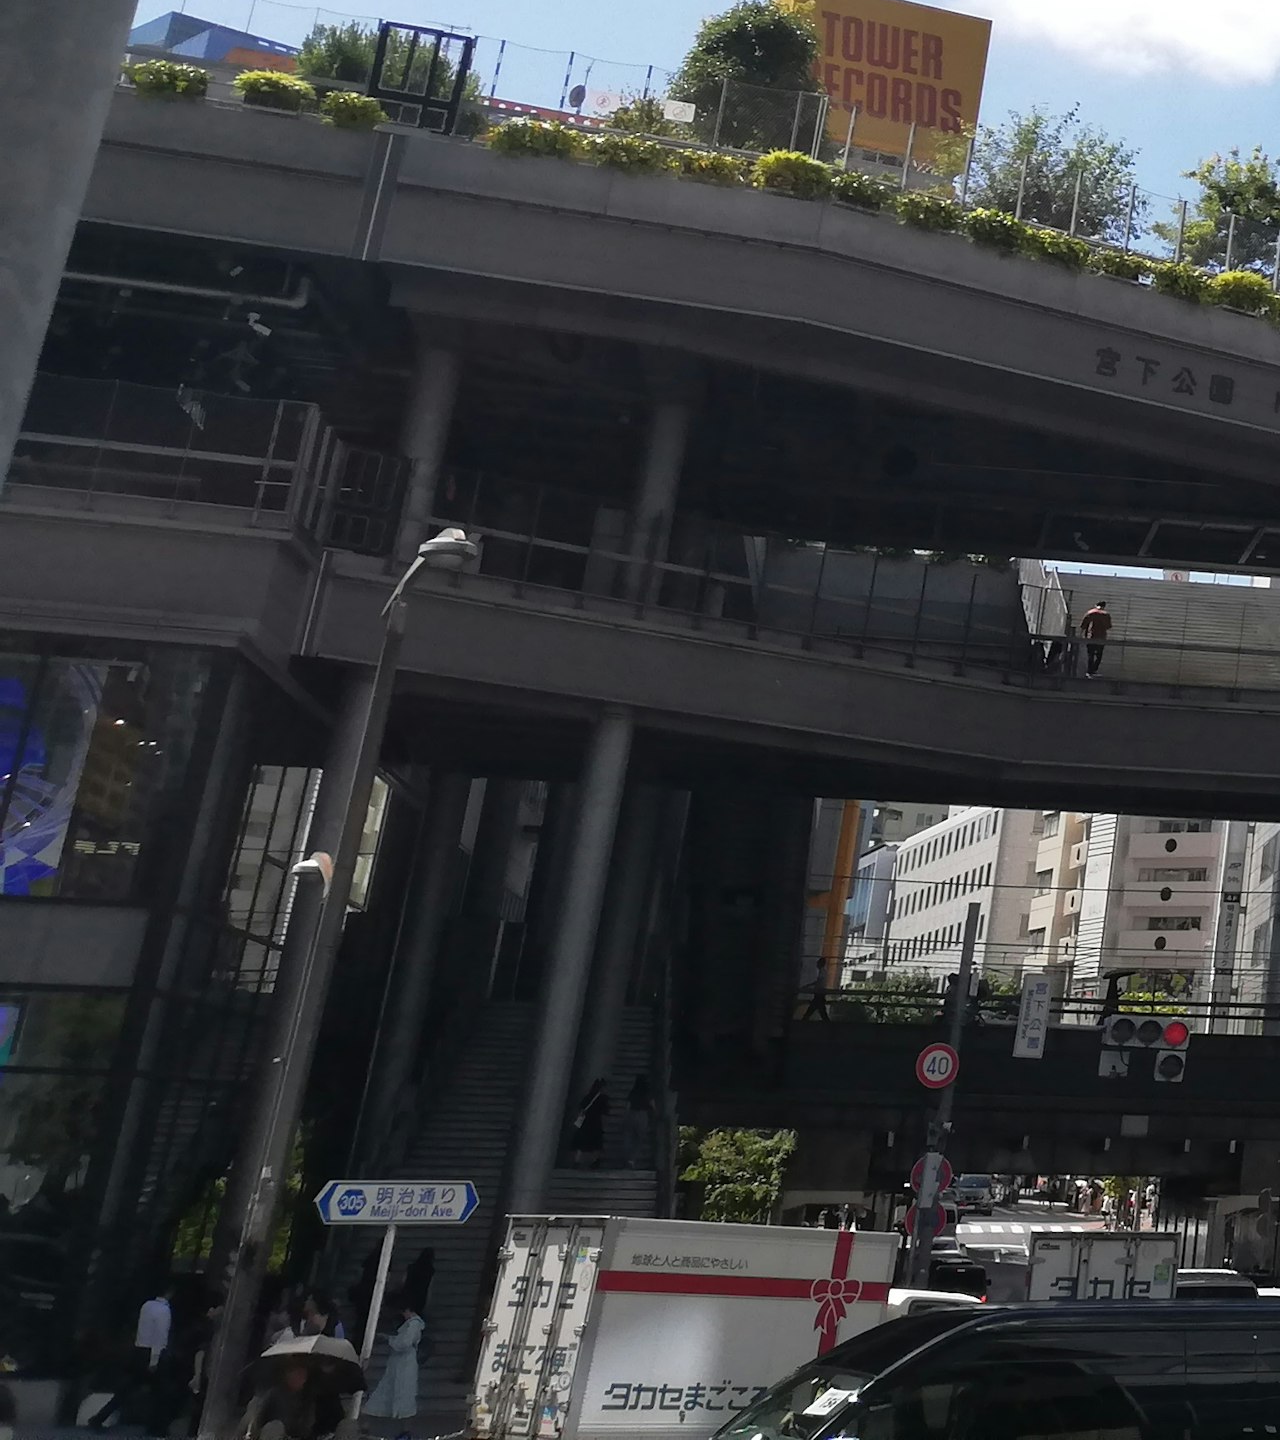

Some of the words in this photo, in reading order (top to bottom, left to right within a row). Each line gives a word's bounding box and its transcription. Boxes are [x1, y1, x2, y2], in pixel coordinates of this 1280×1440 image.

[822, 11, 943, 80] TOWER
[926, 1056, 949, 1076] 40
[340, 1195, 364, 1210] 305
[376, 1187, 456, 1204] 明治通り
[370, 1205, 427, 1220] Meiji-dori
